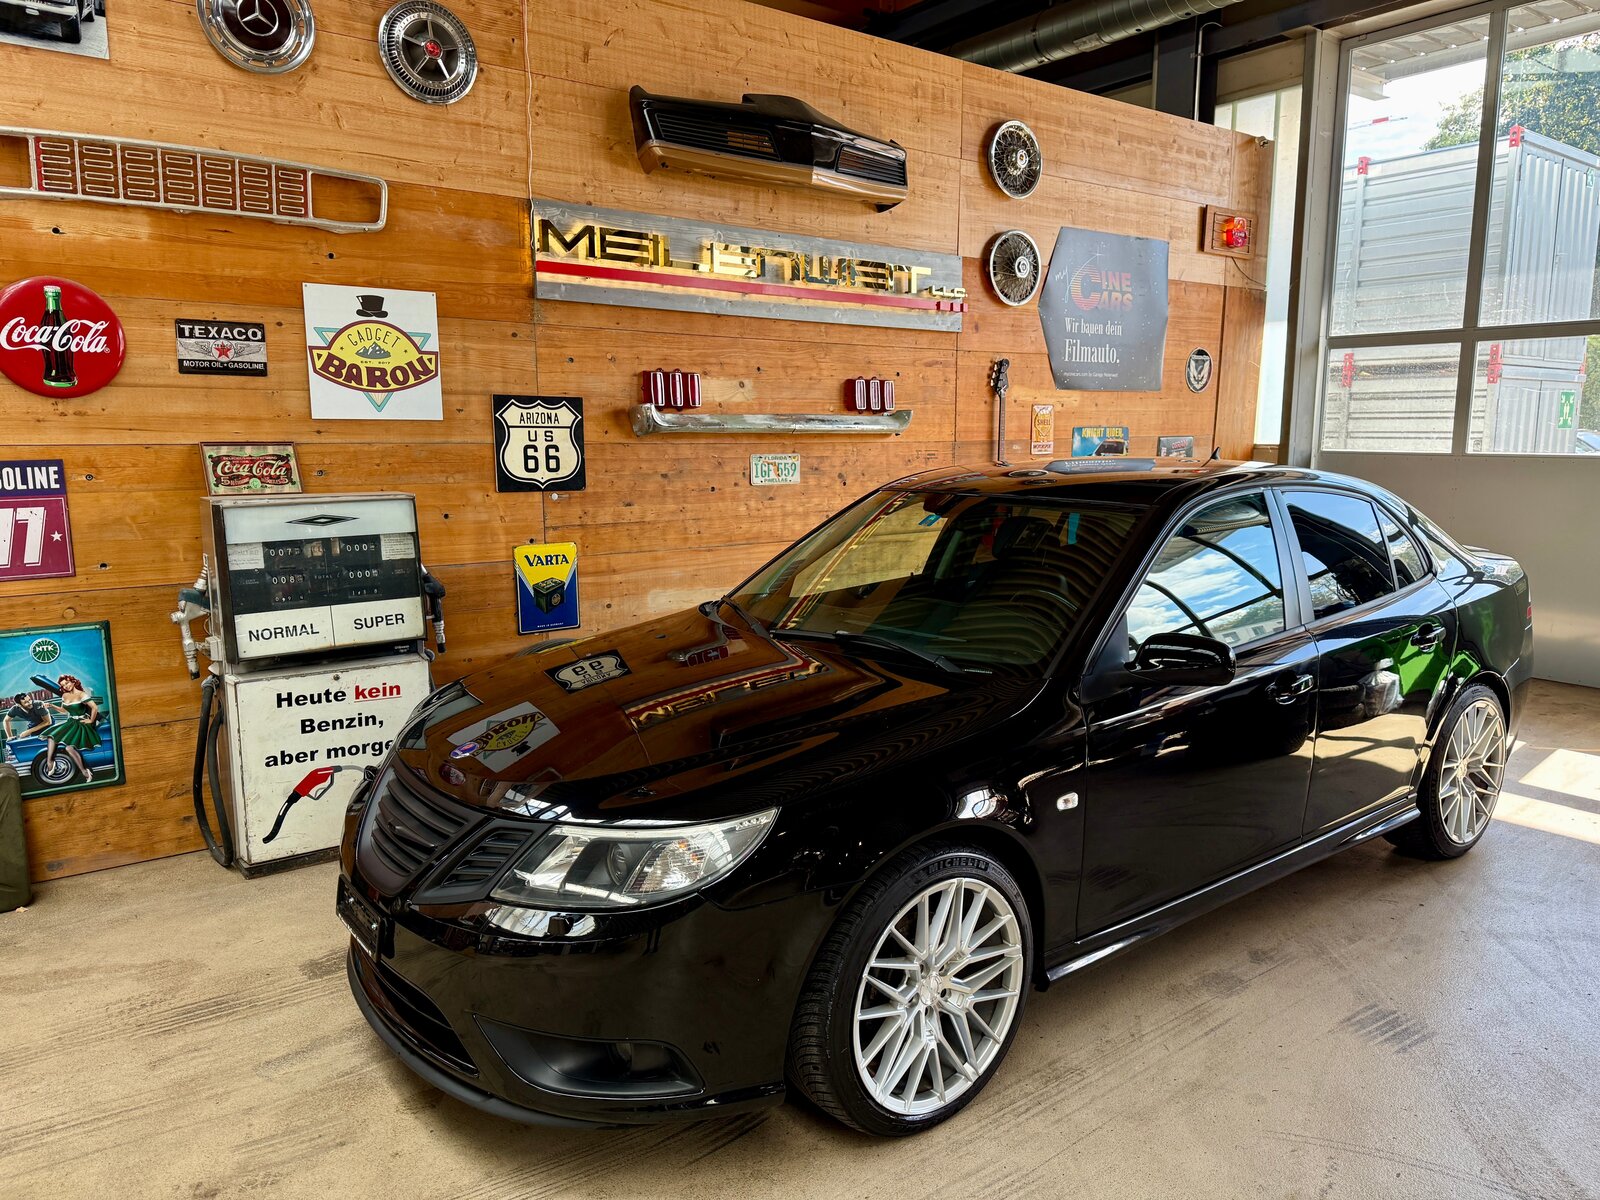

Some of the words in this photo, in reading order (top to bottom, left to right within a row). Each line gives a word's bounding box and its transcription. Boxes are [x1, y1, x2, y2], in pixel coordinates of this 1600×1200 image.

[0, 317, 110, 353] Coca-Cola
[180, 325, 262, 340] TEXACO
[1064, 317, 1080, 333] Wir
[1080, 319, 1104, 336] bauen
[1105, 321, 1122, 336] dein
[347, 327, 401, 348] GADGET
[1064, 339, 1120, 364] Filmauto.
[318, 352, 434, 388] BARON
[519, 412, 560, 424] ARIZONA
[1081, 428, 1104, 438] KNIGHT
[216, 460, 288, 476] Coca-Cola
[523, 444, 560, 473] 66
[0, 466, 60, 490] OLINE
[524, 554, 569, 567] VARTA
[353, 613, 405, 630] SUPER
[248, 623, 319, 642] NORMAL
[35, 645, 54, 653] NTK
[276, 688, 347, 708] Heute
[354, 682, 401, 700] kein
[300, 713, 384, 734] Benzin,
[264, 749, 319, 768] aber
[929, 857, 988, 873] MICHELIN
